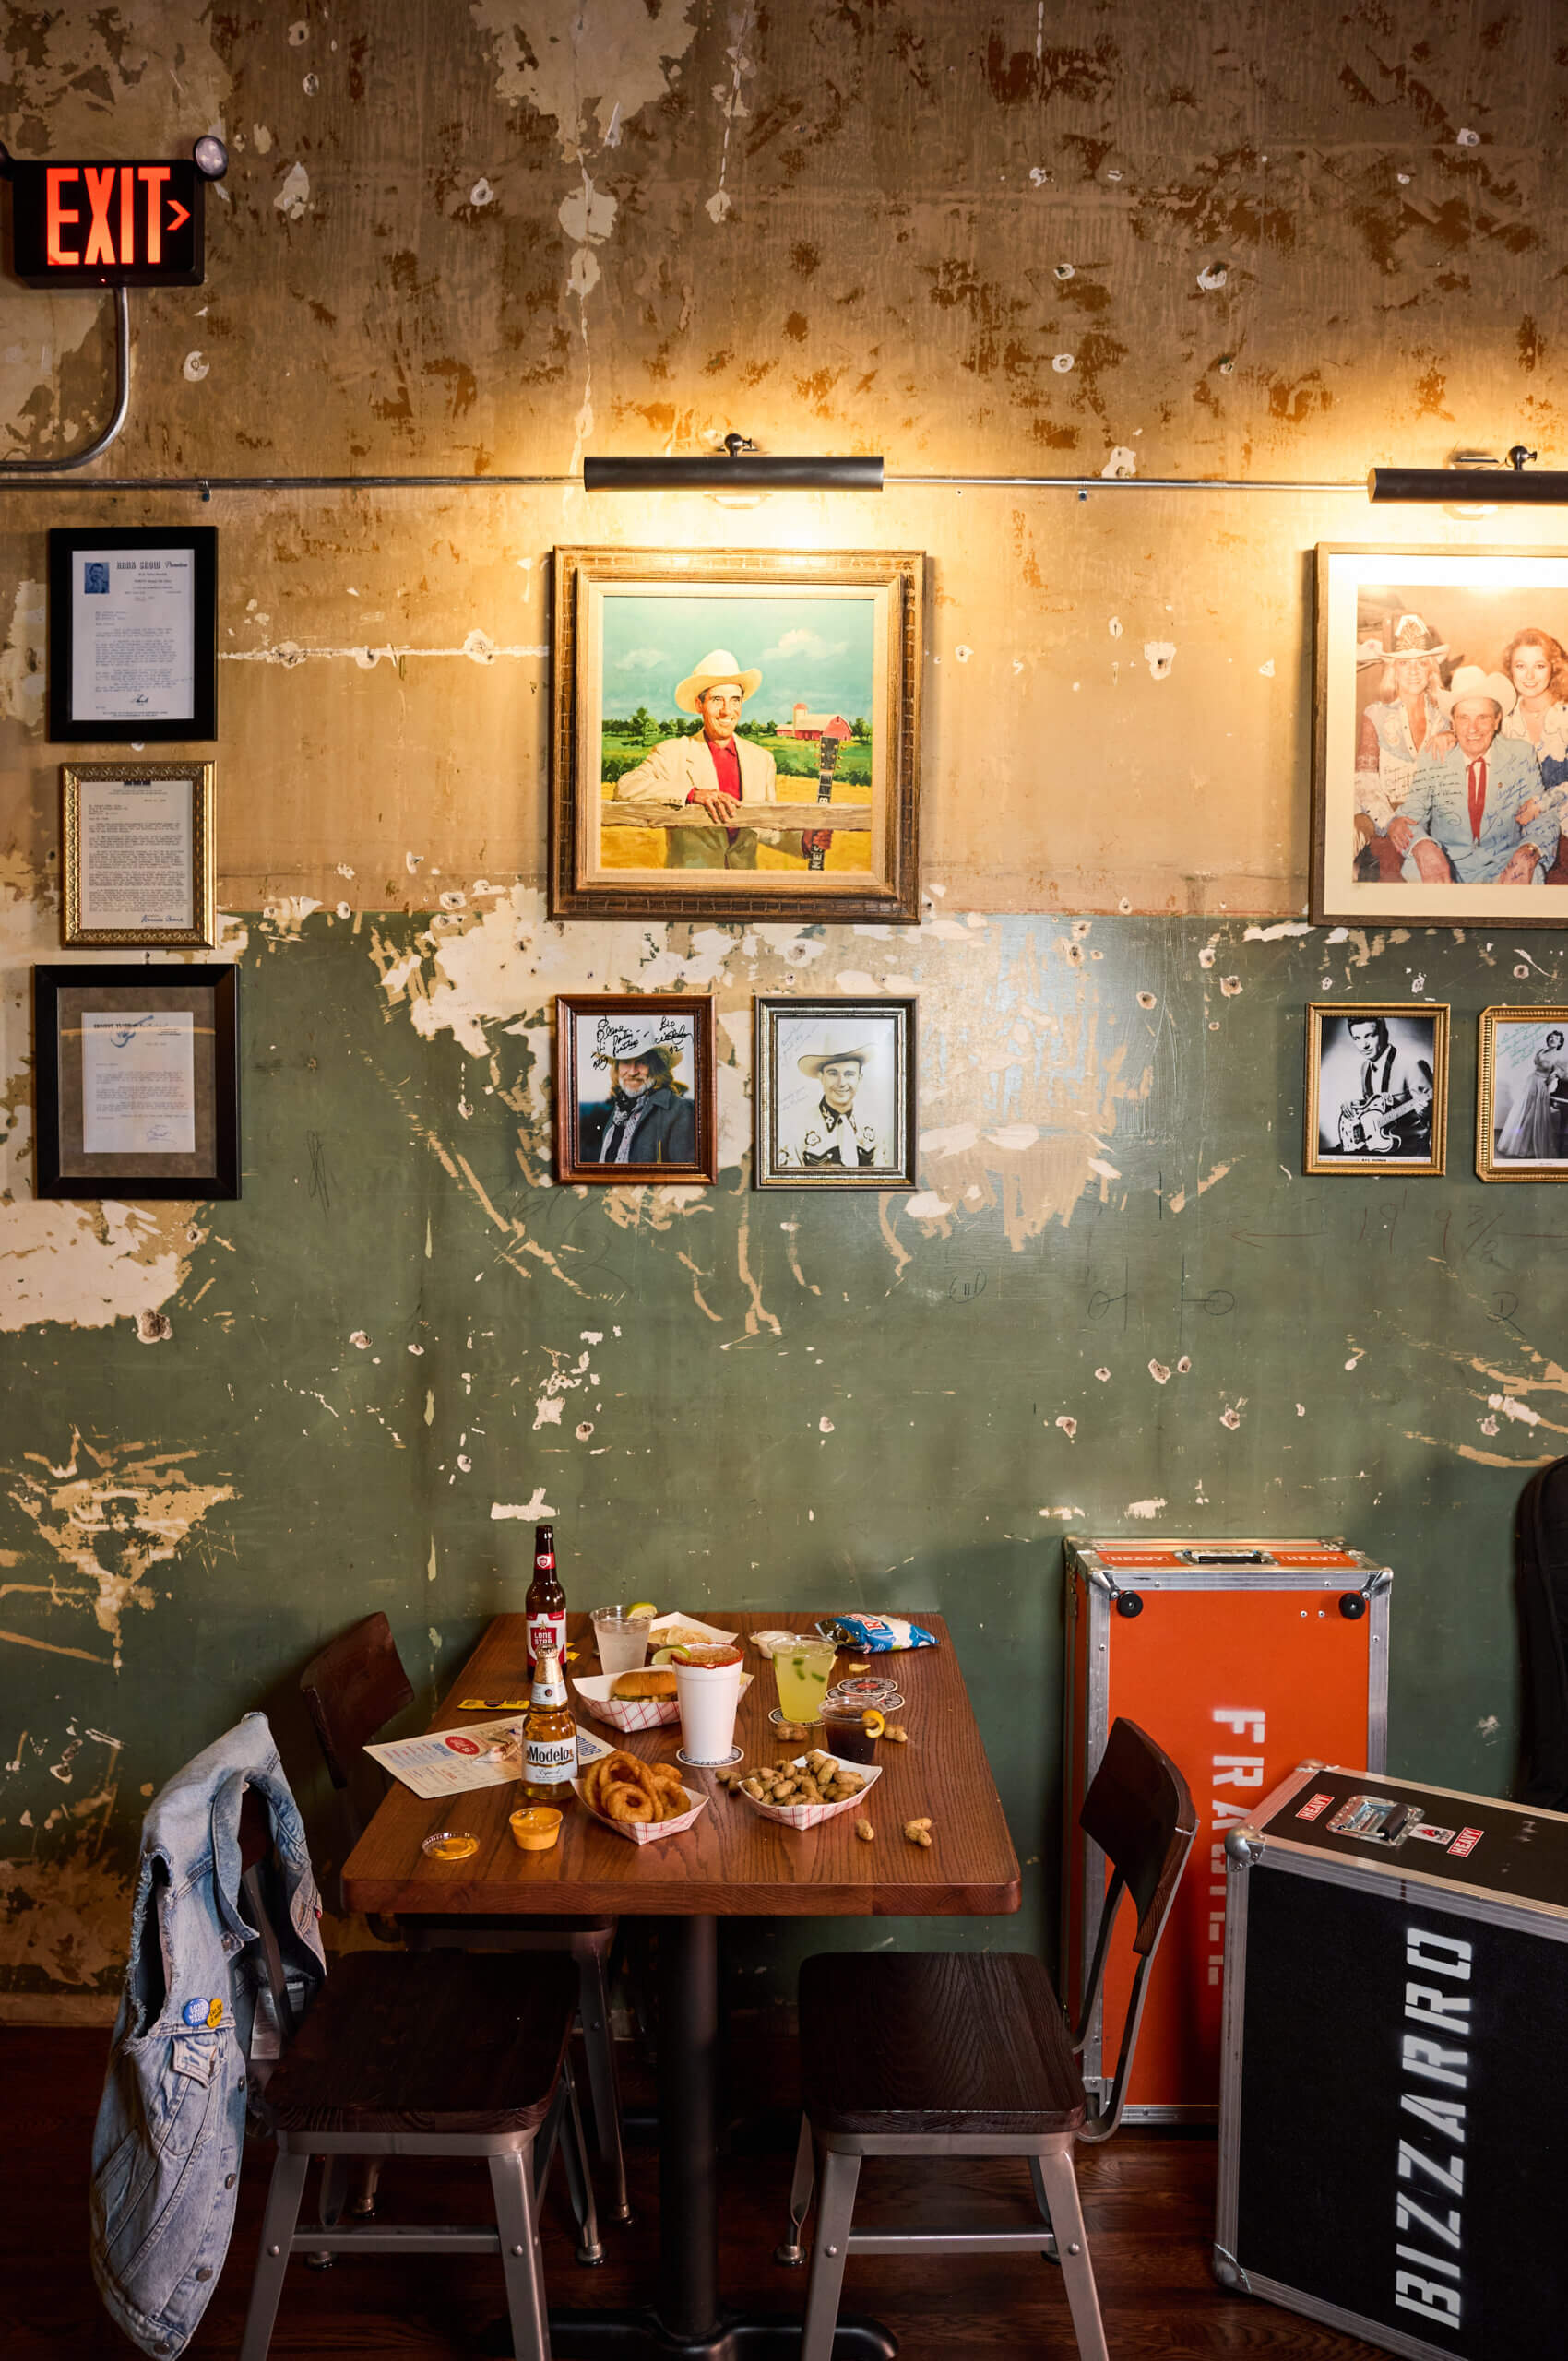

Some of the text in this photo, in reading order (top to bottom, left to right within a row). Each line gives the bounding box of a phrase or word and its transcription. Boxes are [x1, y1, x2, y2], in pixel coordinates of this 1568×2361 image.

[47, 167, 170, 266] EXIT
[534, 1631, 552, 1639] LONE
[529, 1745, 569, 1762] Modelo
[1299, 1795, 1330, 1819] HEAVY
[1450, 1829, 1481, 1855] HEAVY
[1395, 1928, 1472, 2330] BIZZARRO
